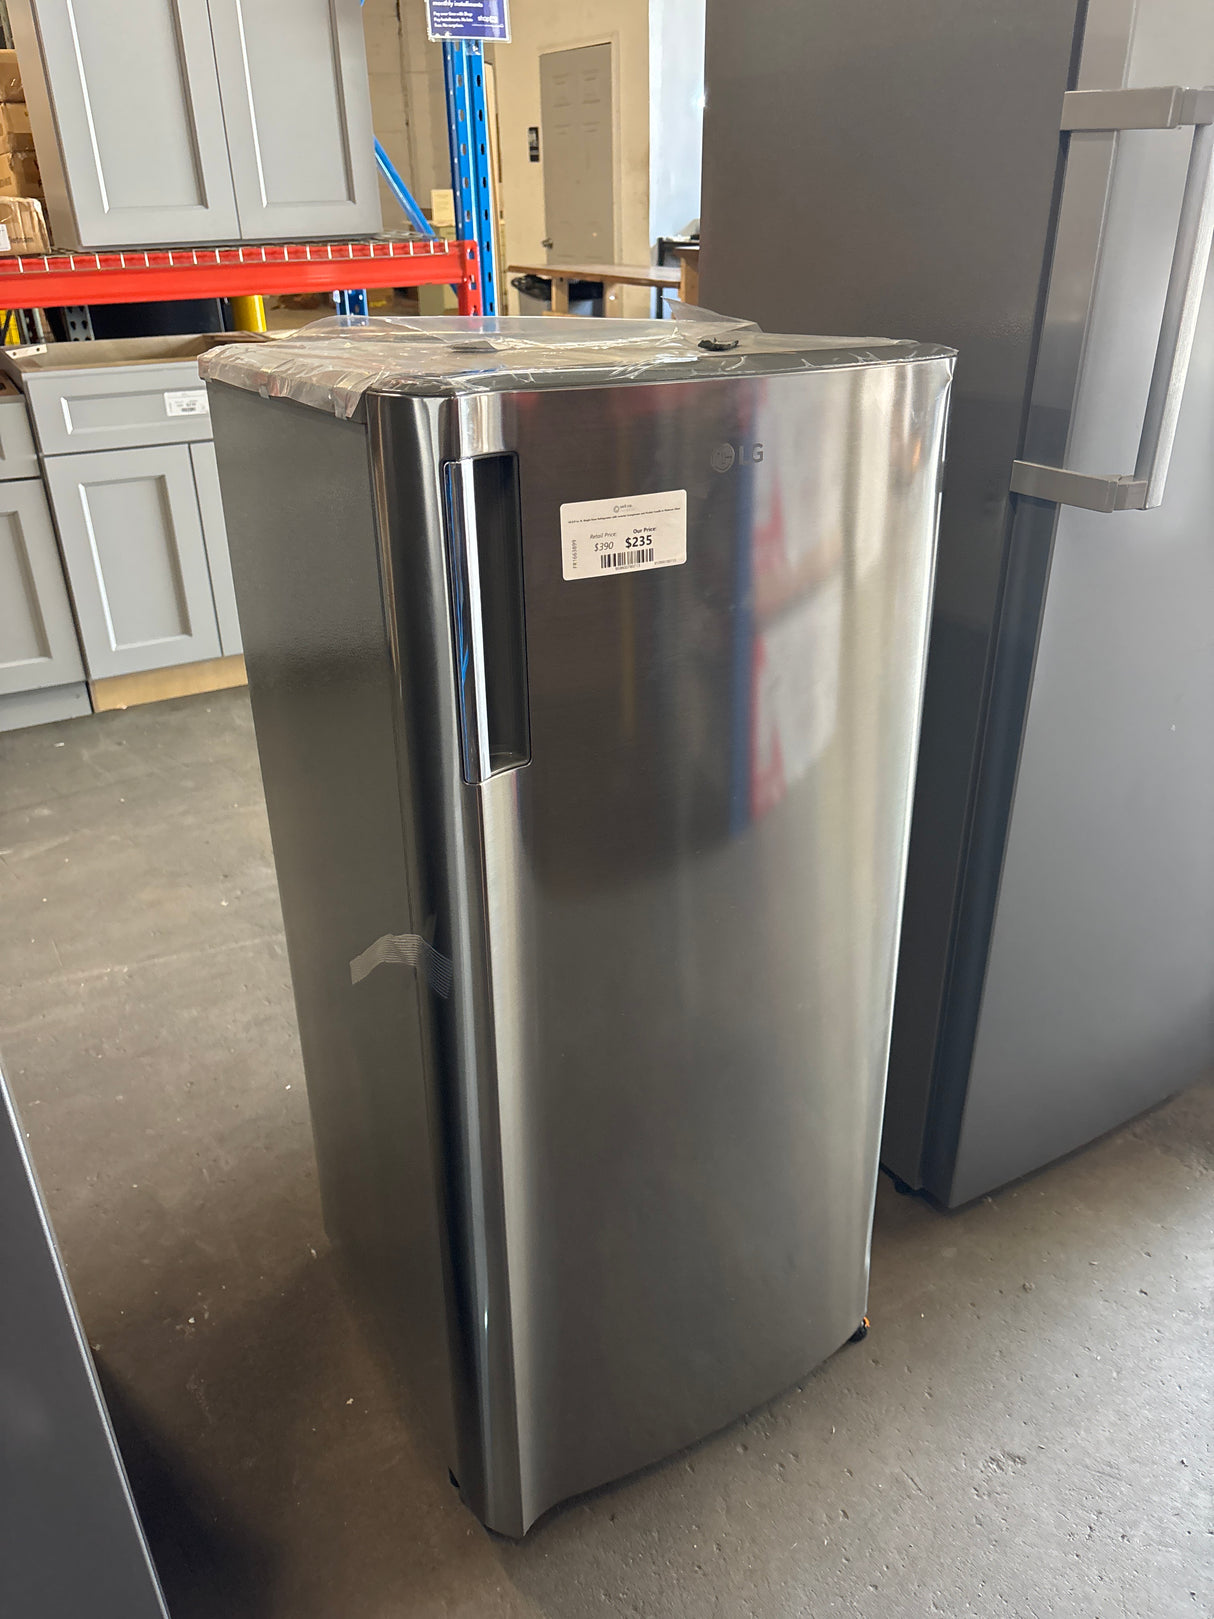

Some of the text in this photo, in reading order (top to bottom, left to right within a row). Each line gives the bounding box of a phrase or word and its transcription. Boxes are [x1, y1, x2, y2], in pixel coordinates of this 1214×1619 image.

[454, 0, 483, 8] installments
[738, 442, 764, 465] LG
[589, 532, 604, 540] Retail
[625, 534, 653, 549] $235
[594, 541, 614, 552] $390
